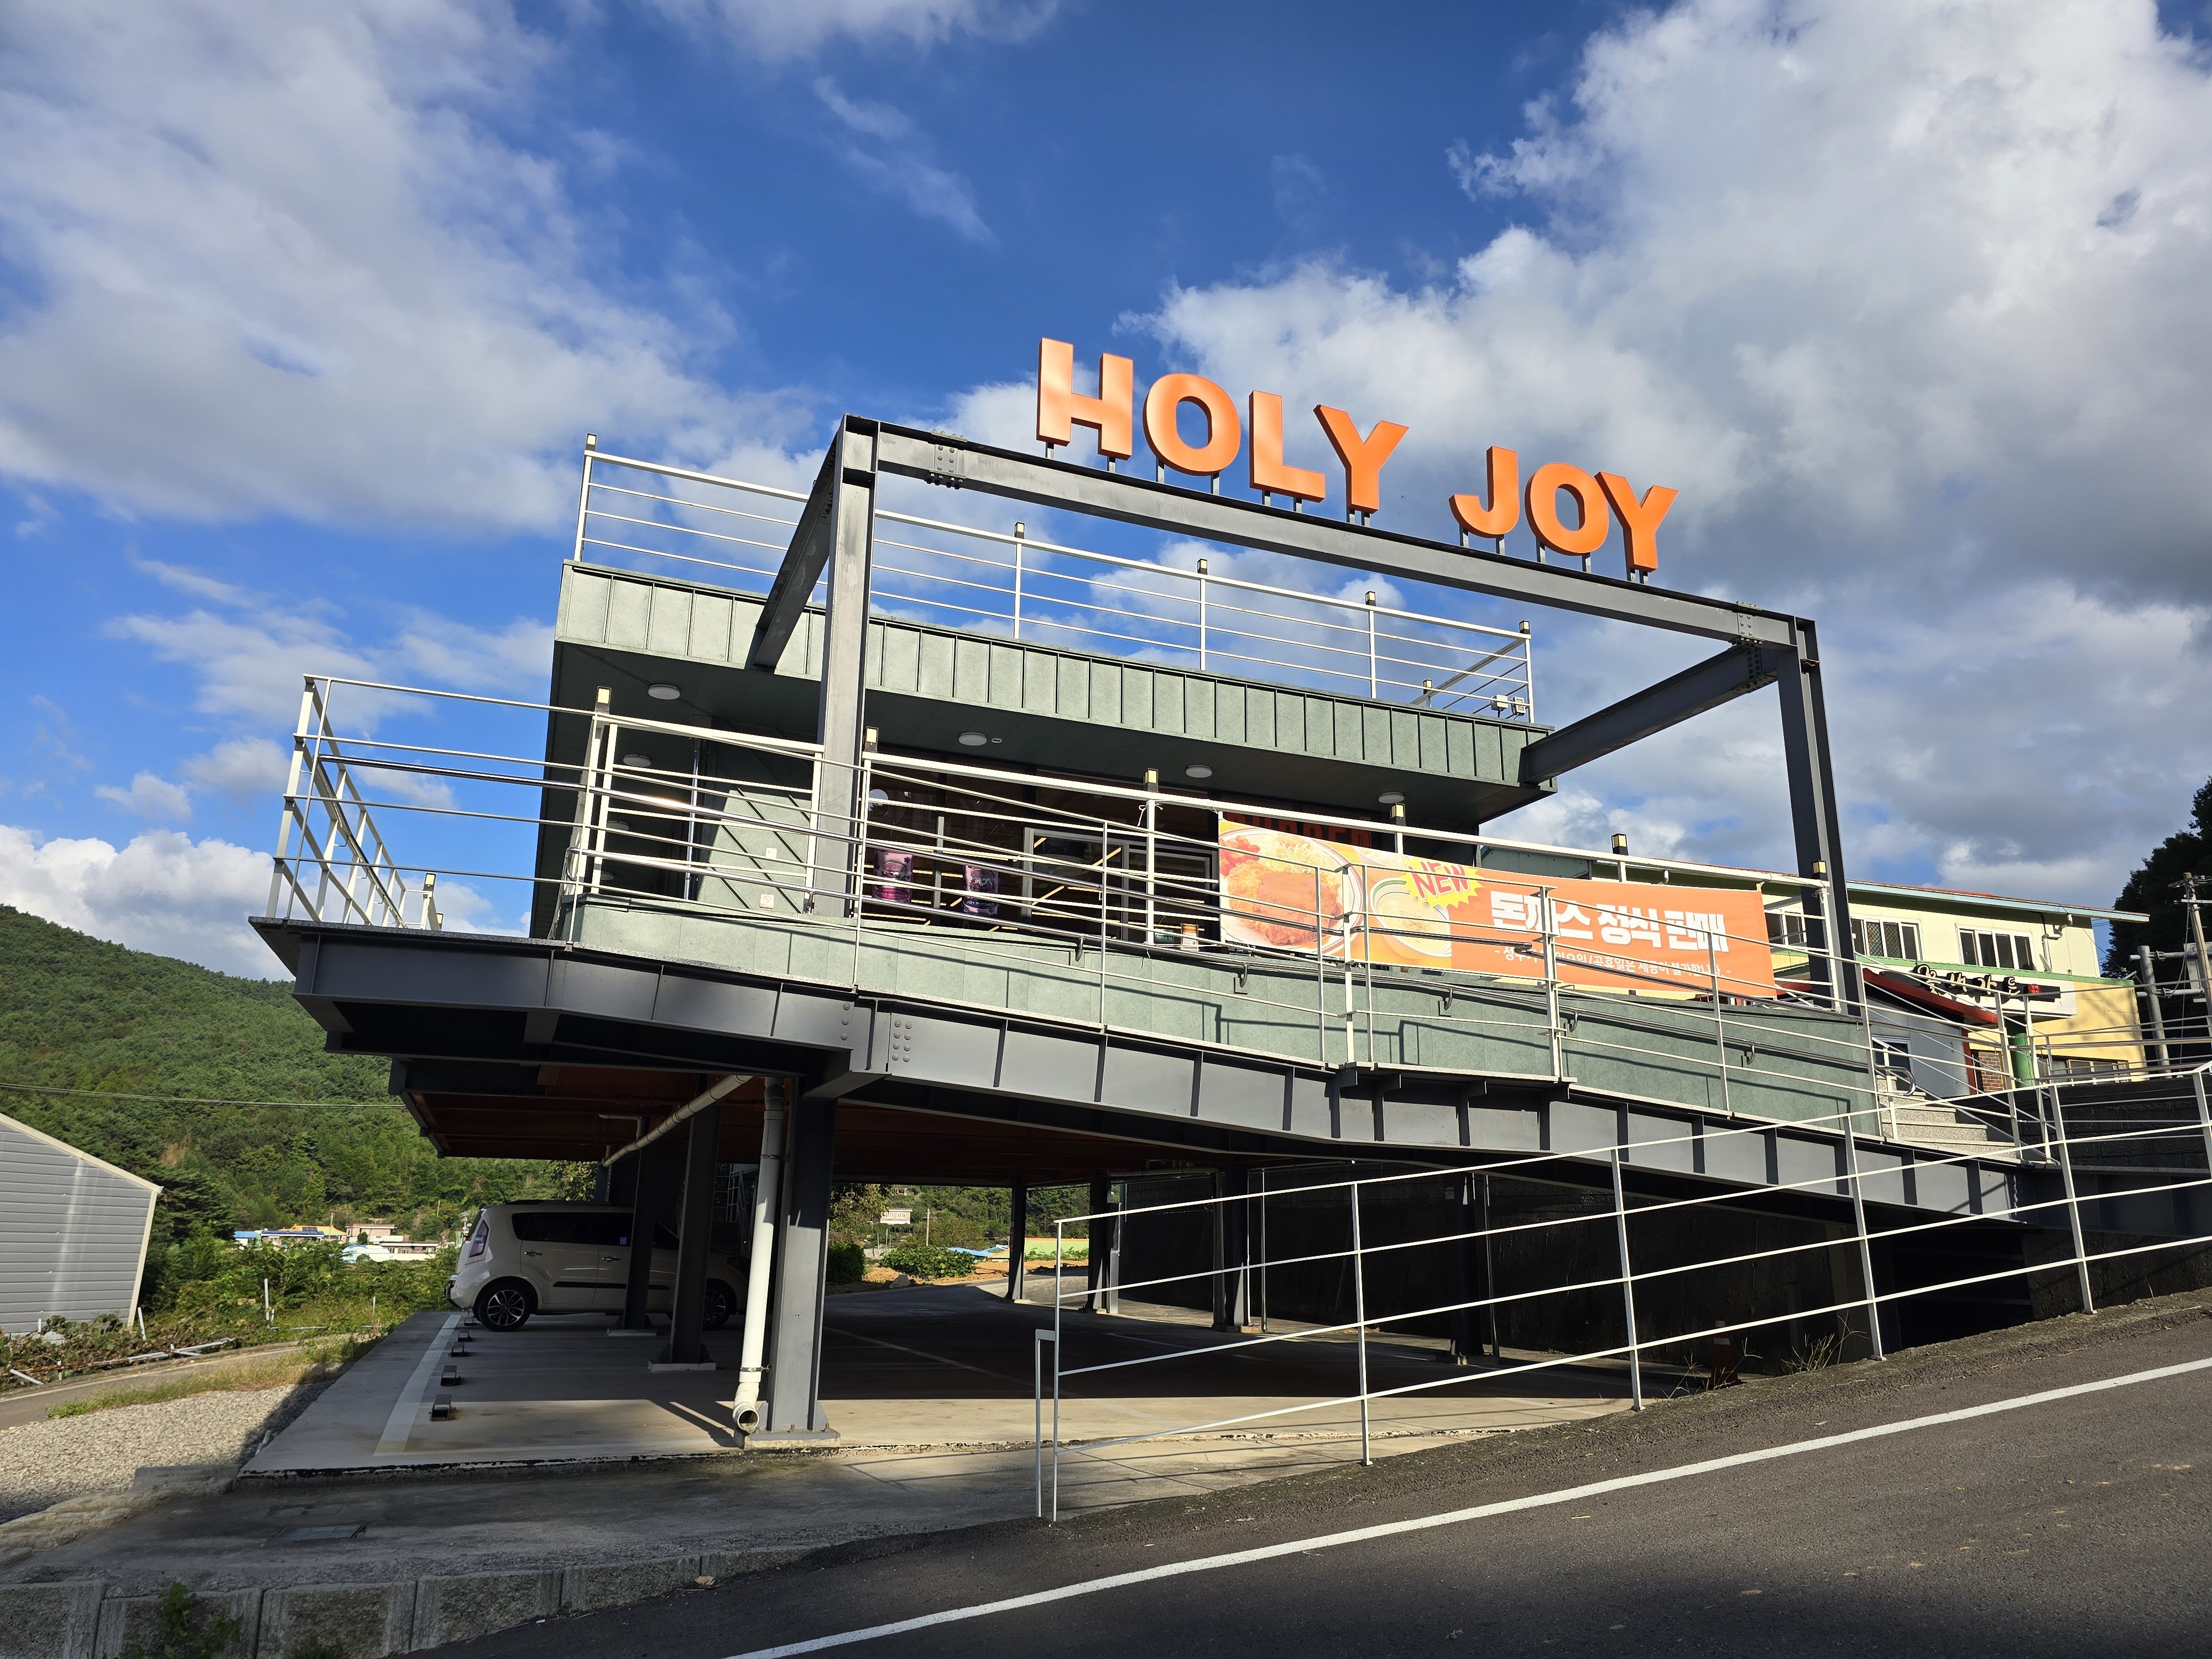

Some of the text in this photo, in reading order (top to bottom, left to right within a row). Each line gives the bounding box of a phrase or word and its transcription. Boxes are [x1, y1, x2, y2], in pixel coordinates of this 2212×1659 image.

[1036, 338, 1679, 573] HOLY JOY
[1407, 861, 1469, 899] NEW
[1490, 891, 1729, 952] 돈까스 정식 판매
